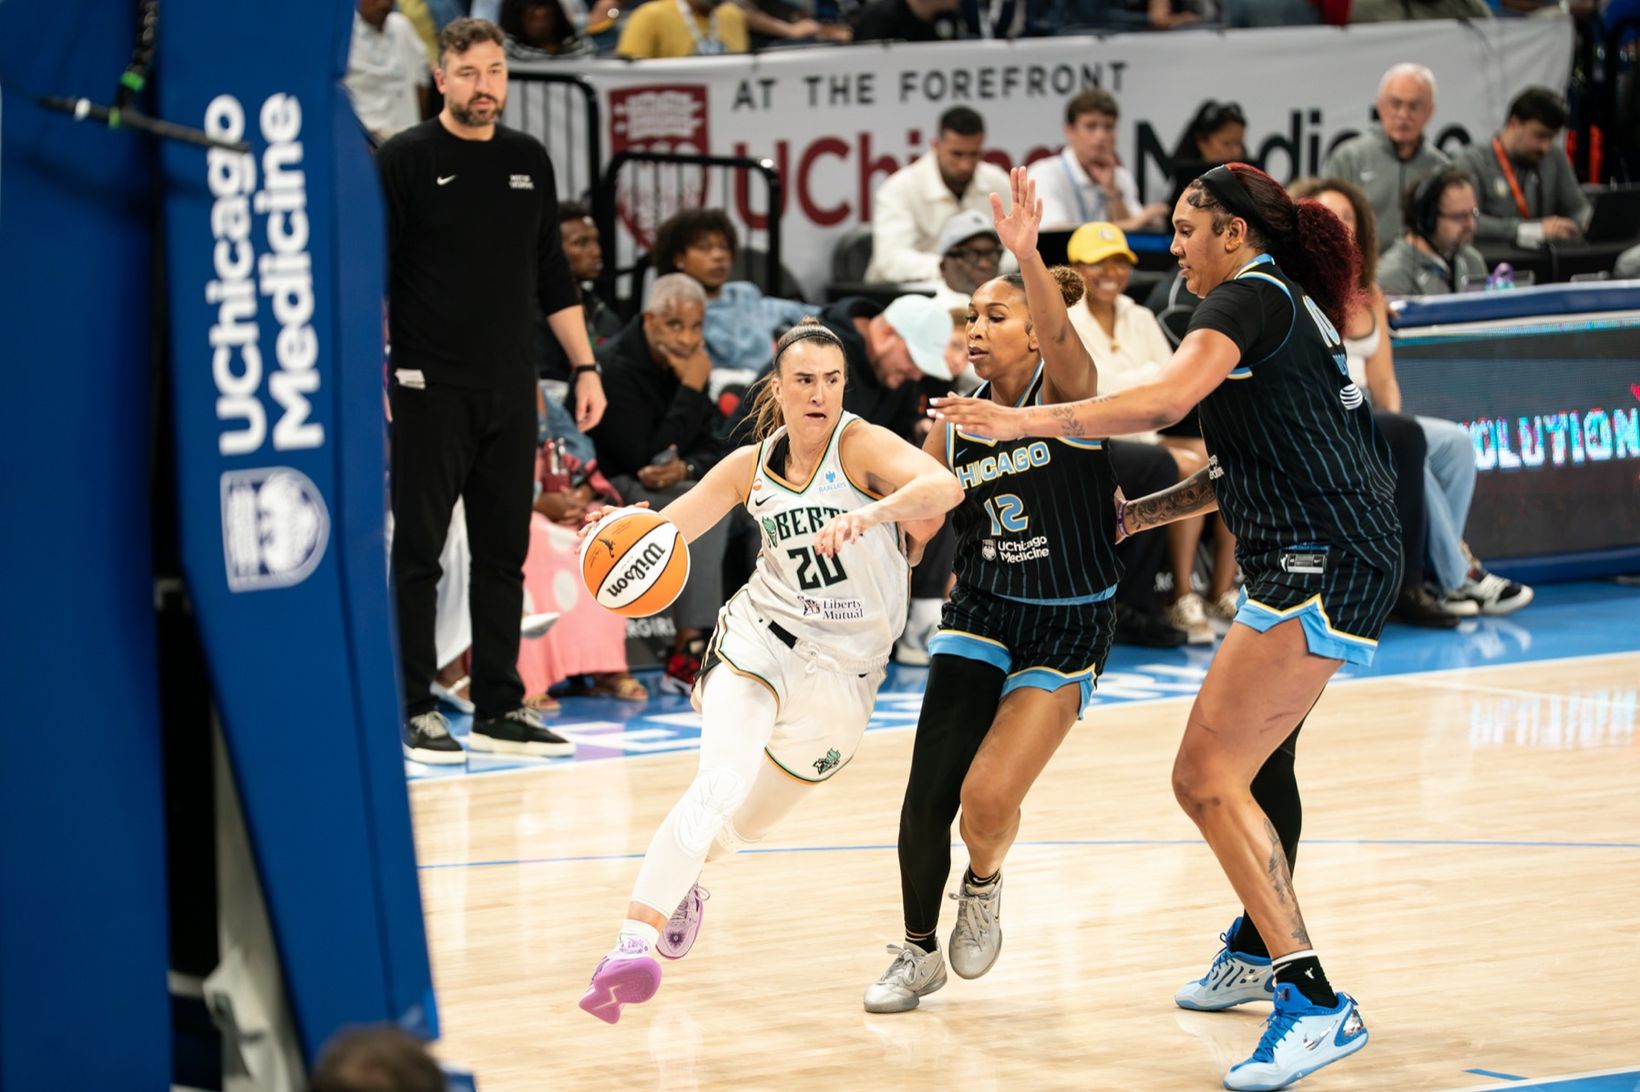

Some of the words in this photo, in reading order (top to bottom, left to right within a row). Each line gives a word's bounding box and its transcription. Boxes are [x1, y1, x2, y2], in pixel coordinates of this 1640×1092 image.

[732, 78, 778, 111] AT
[804, 73, 875, 105] THE
[901, 61, 1127, 101] FOREFRONT
[204, 94, 267, 456] UChicago
[254, 92, 325, 451] Medicine
[1457, 408, 1640, 470] OLUTION
[955, 441, 1051, 490] HICAGO
[984, 494, 1029, 536] 12
[606, 542, 666, 597] Wilson
[787, 545, 848, 590] 20
[1000, 547, 1049, 564] Medicine
[823, 599, 861, 610] Liberty
[823, 608, 863, 620] Mutual
